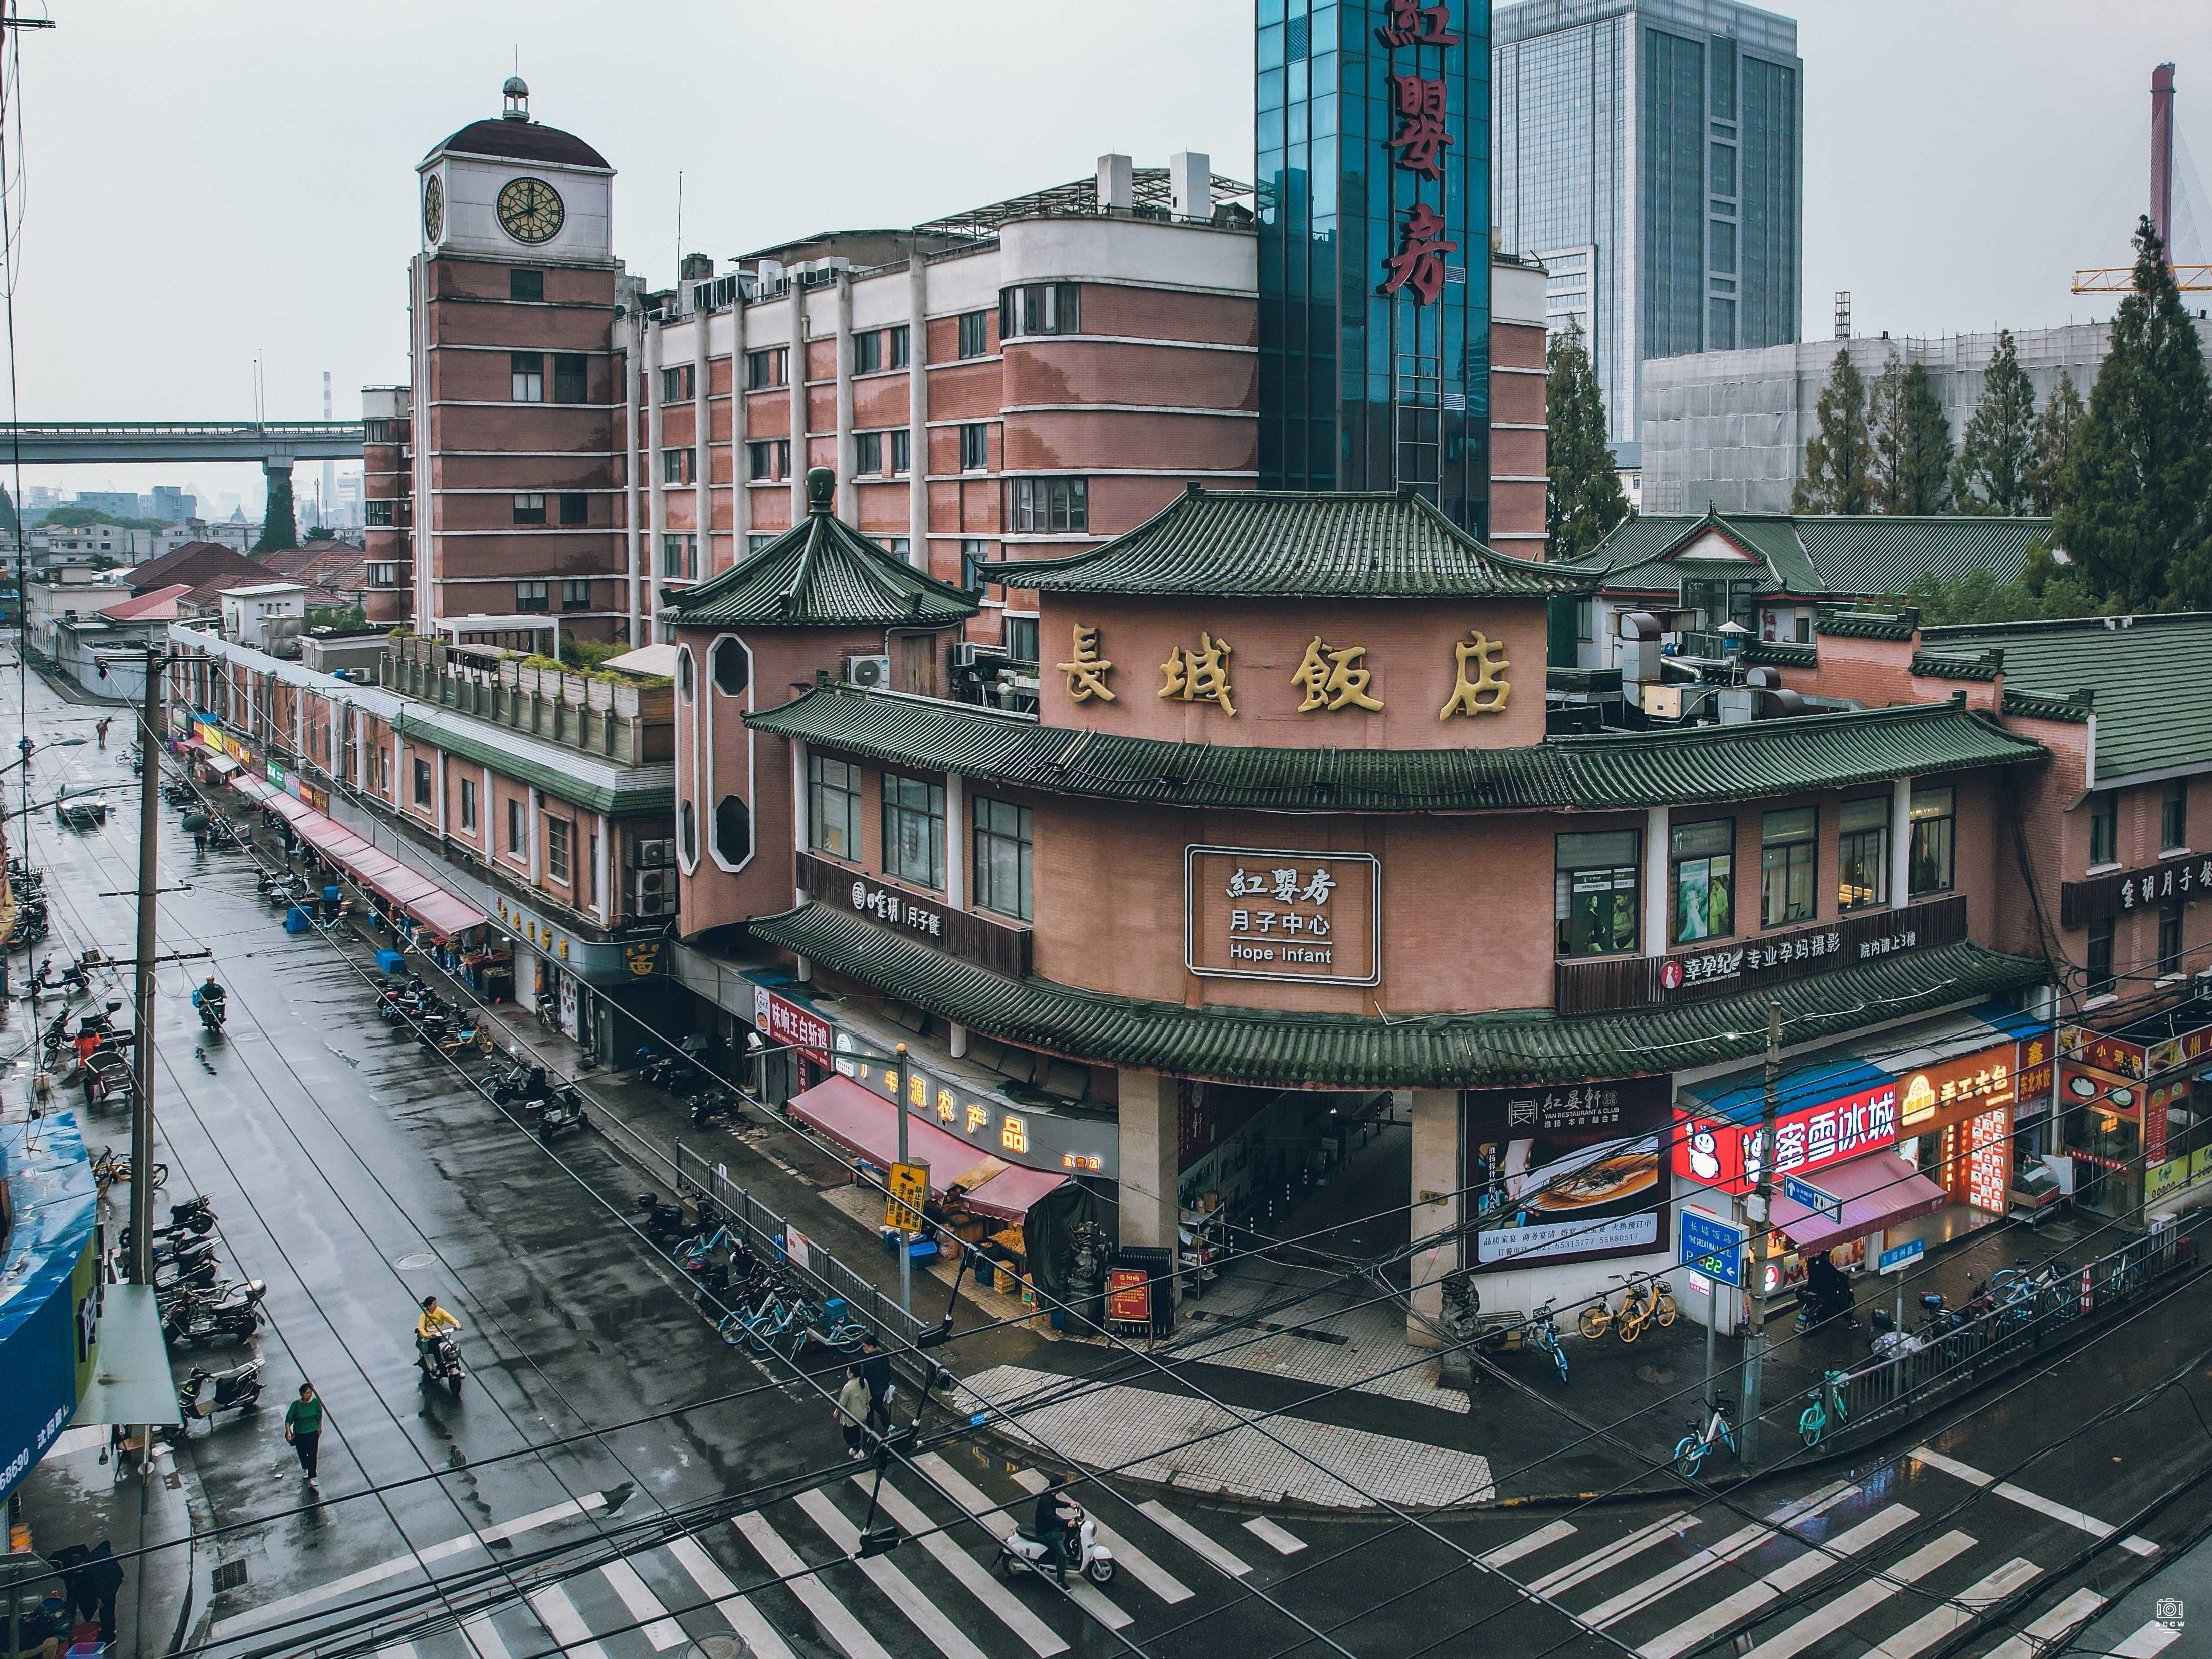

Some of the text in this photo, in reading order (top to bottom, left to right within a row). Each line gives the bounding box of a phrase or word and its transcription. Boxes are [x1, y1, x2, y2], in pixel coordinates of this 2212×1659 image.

[1056, 622, 1509, 721] 長城飯店
[908, 907, 941, 936] 月子餐
[1230, 910, 1330, 935] 月子中心
[1230, 943, 1331, 963] Hope Infant
[1746, 933, 1840, 969] 专业孕妈摄影
[1860, 931, 1916, 958] 院内请上3楼
[2020, 1067, 2050, 1095] 东北水饺
[1558, 1109, 1596, 1118] RESTAURANT
[1775, 1091, 1894, 1173] 蜜雪冰城
[1599, 1233, 1639, 1243] 55880517
[1690, 1221, 1732, 1244] 长城饭店
[1697, 1237, 1709, 1249] GREAT
[1686, 1250, 1693, 1260] P
